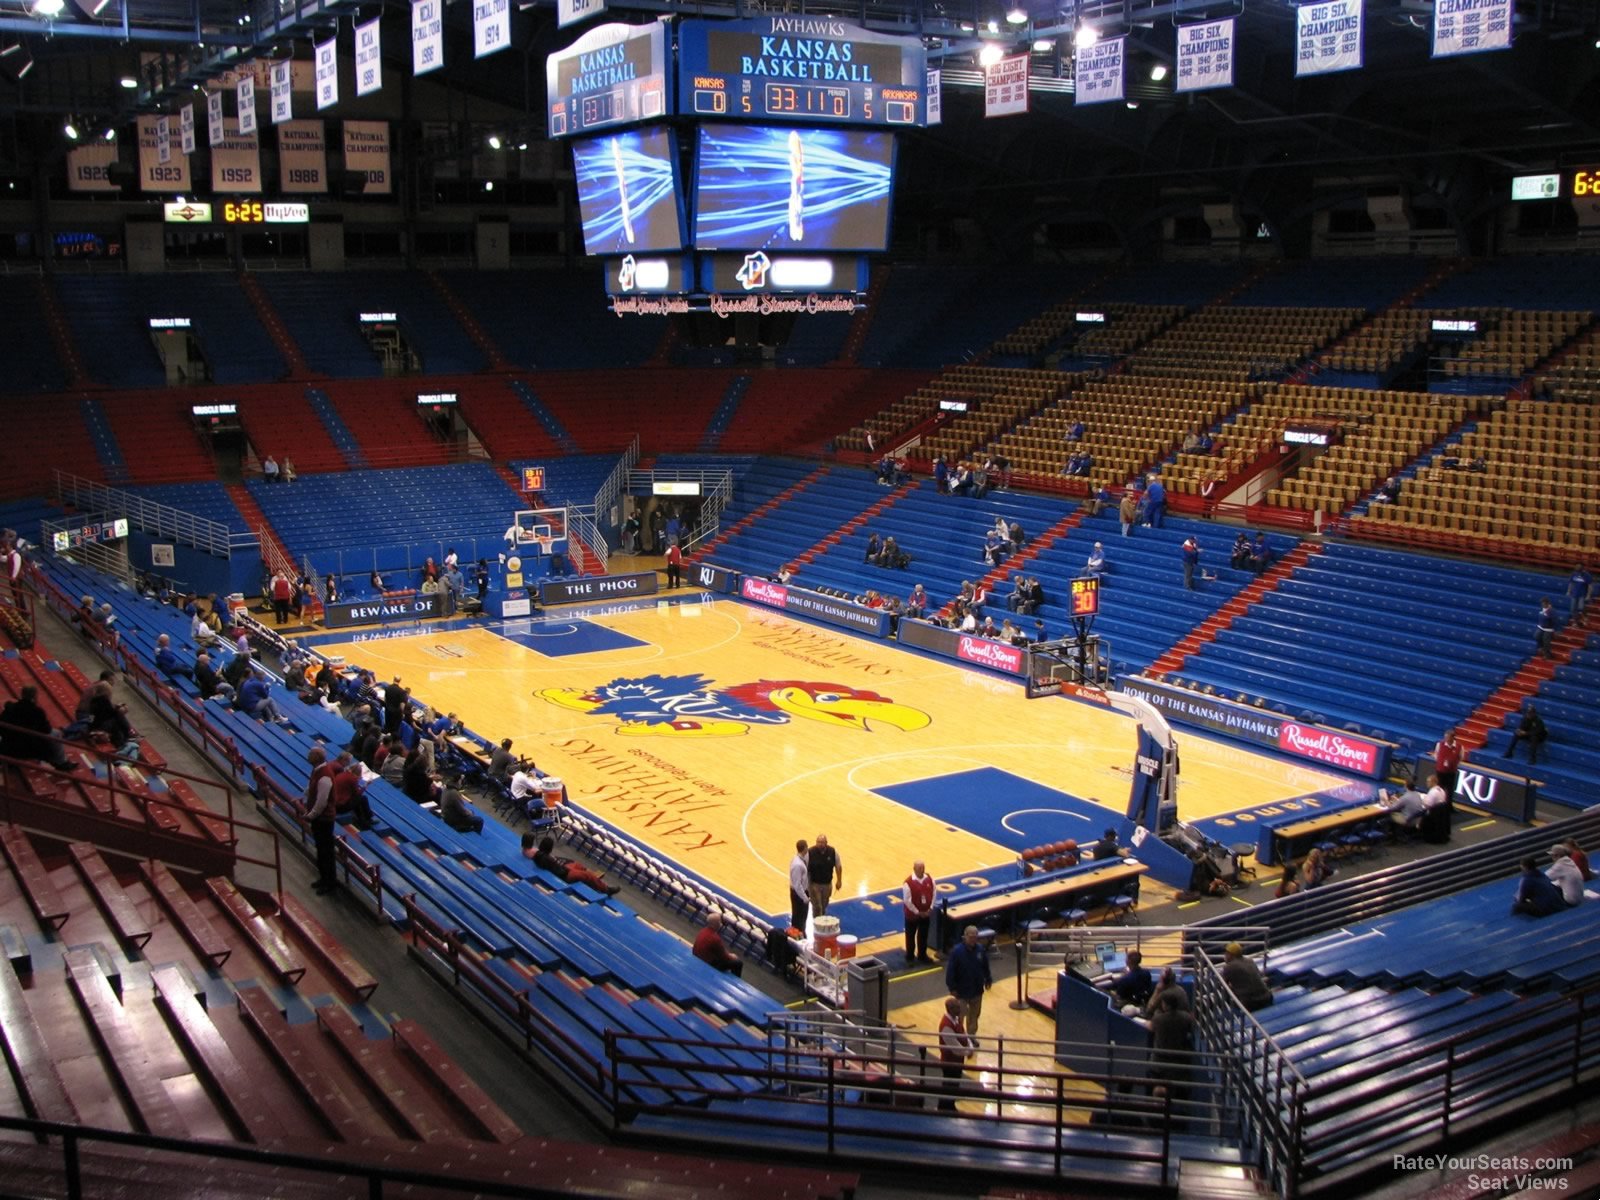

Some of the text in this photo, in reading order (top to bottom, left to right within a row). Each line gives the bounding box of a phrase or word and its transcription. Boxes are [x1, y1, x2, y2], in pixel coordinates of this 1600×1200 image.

[1312, 3, 1347, 21] BIG SIX
[1440, 8, 1506, 28] 1915 1922 1923
[770, 17, 845, 36] JAYHAWKS
[1190, 25, 1221, 41] BIG SIX
[1301, 16, 1358, 38] CHAMPIONS
[1438, 28, 1454, 39] 1924
[1462, 25, 1480, 36] 1925
[761, 37, 852, 62] KANSAS
[1080, 42, 1119, 59] BIG SEVEN
[1180, 38, 1230, 56] CHAMPIONS
[1462, 37, 1479, 48] 1927
[580, 44, 625, 73] KANSAS
[990, 59, 1024, 74] BIG EIGHT
[1078, 55, 1121, 72] CHAMPIONS
[572, 62, 636, 94] BASKETBALL
[742, 56, 873, 83] BASKETBALL
[988, 71, 1025, 86] CHAMPIONS
[694, 78, 724, 90] KANSAS
[713, 92, 724, 112] 0
[882, 89, 918, 100] ARKANSAS
[742, 96, 751, 113] 5
[834, 97, 844, 116] 0
[864, 103, 872, 120] 5
[904, 105, 912, 122] 0
[150, 168, 182, 182] 1923
[221, 168, 252, 182] 1952
[289, 170, 319, 183] 1988
[225, 203, 263, 222] 6:25
[709, 295, 857, 318] Russell Stover Candies
[528, 476, 540, 488] 30
[700, 566, 715, 586] KU
[566, 579, 637, 595] THE PHOG
[745, 578, 766, 596] Russell
[351, 600, 433, 618] BEWARE OF
[786, 595, 878, 626] HOME OF THE KANSAS JAYHAWKS
[1074, 592, 1094, 612] 30
[961, 637, 1017, 665] Russell Stover
[650, 692, 732, 714] KU
[1123, 686, 1280, 738] HOME OF THE KANSAS JAYHAWKS
[1284, 724, 1369, 764] Russell Stover
[1138, 754, 1160, 770] MUSCLE
[1308, 750, 1363, 770] CANDIES
[551, 738, 729, 814] JAYHAWKS
[627, 748, 733, 797] Allen Fieldhouse
[1454, 770, 1498, 804] KU
[580, 784, 728, 852] KANSAS
